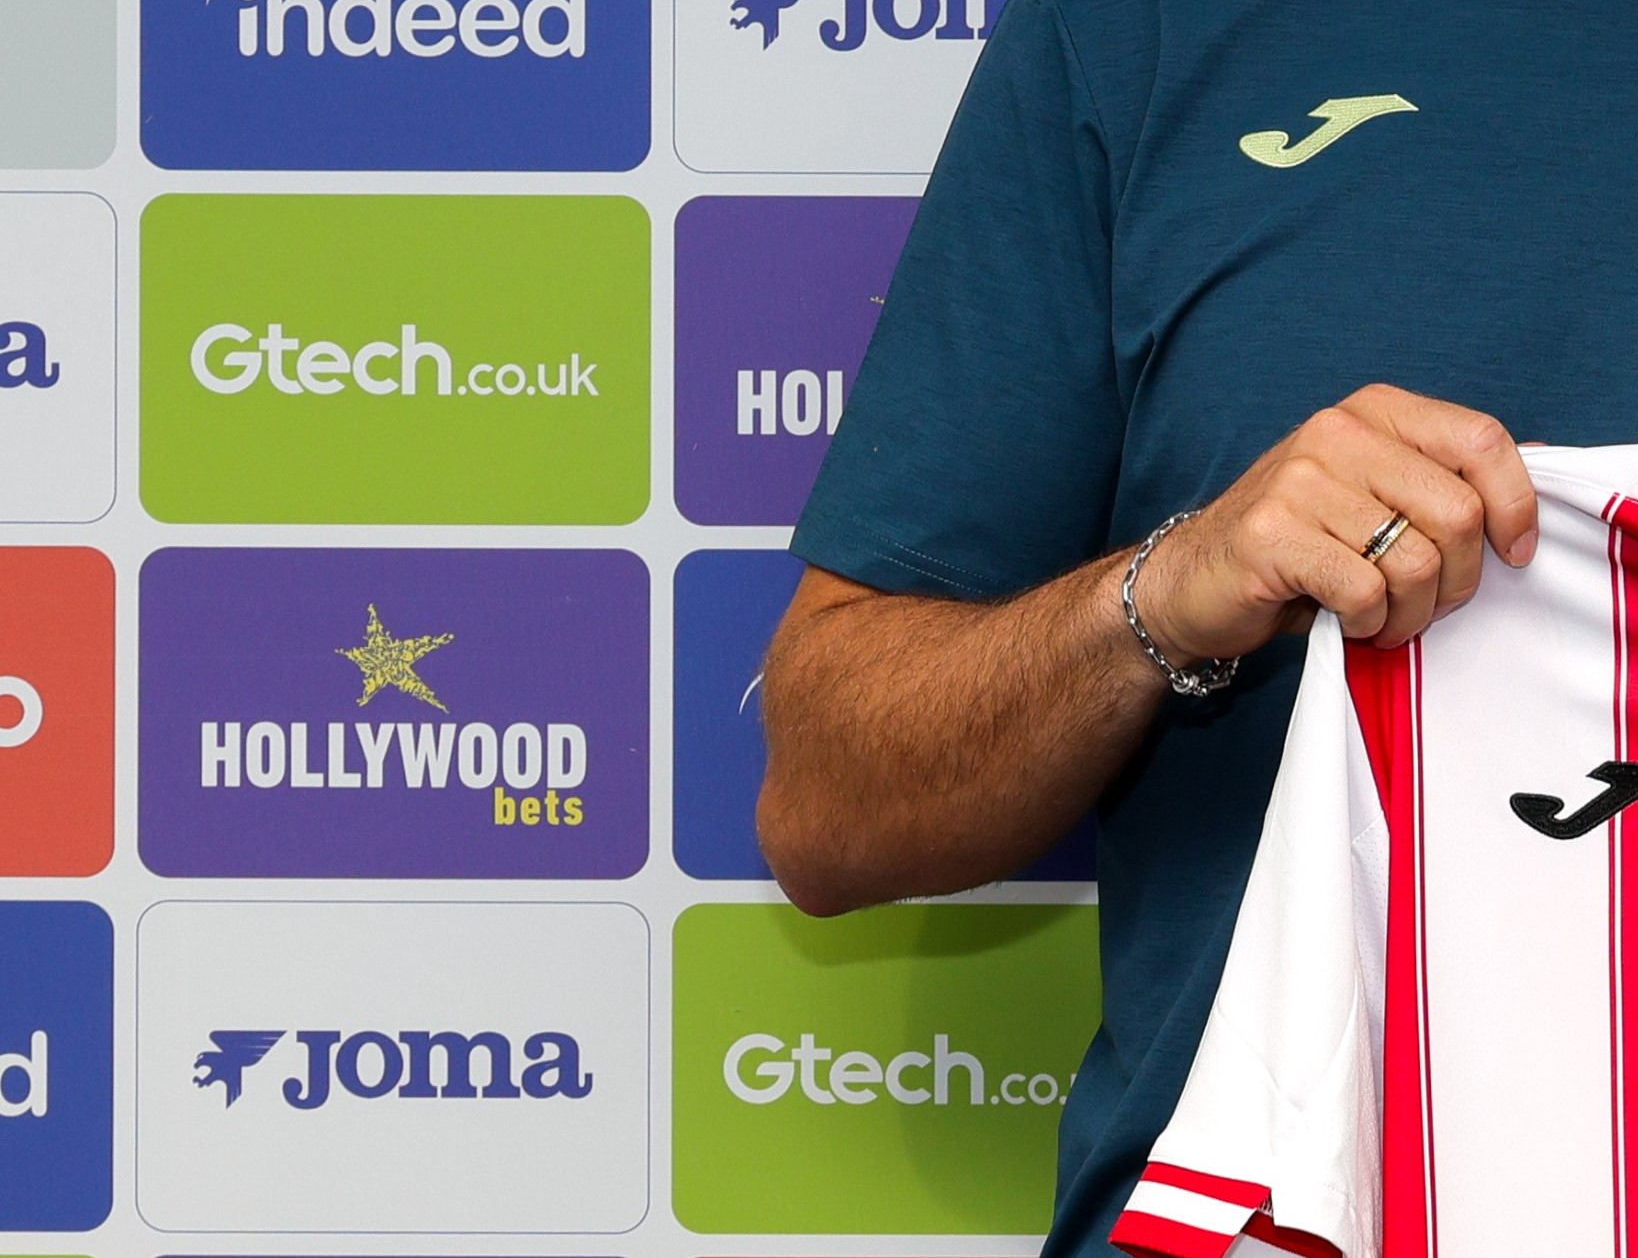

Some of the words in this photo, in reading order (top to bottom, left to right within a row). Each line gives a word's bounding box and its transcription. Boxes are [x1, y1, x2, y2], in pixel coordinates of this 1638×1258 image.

[190, 323, 599, 396] Gtech.co.uk
[201, 721, 587, 790] HOLLYWOOD
[494, 788, 584, 826] bets
